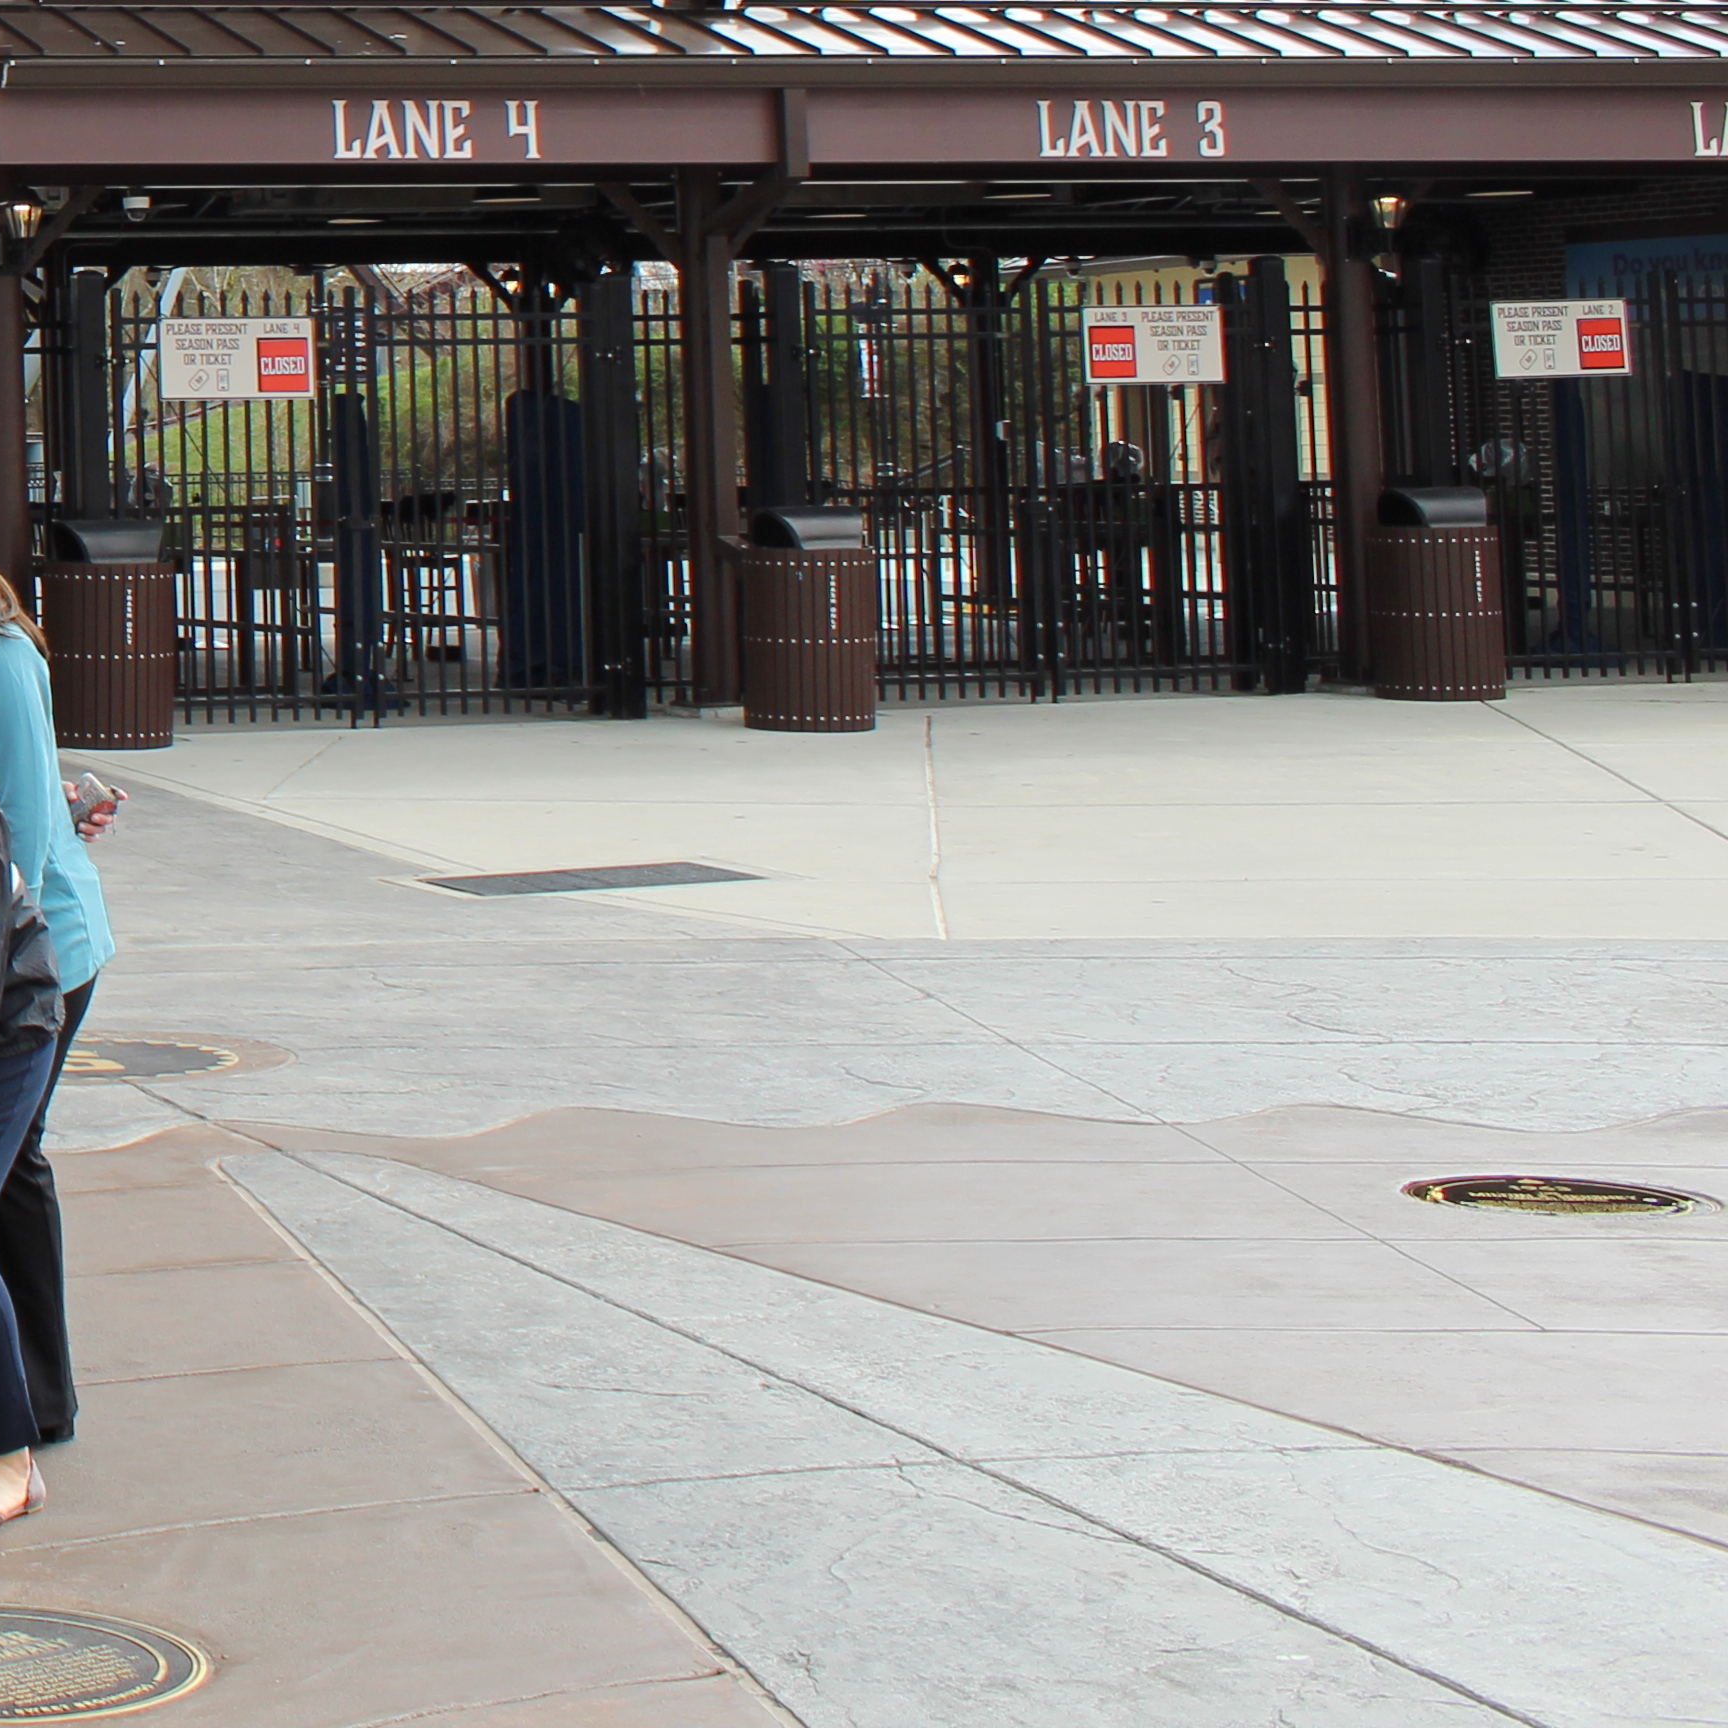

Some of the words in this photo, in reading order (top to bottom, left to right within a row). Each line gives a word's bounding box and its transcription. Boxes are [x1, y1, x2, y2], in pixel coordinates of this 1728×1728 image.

[331, 100, 473, 160] LANE
[505, 100, 541, 160] 4
[1037, 100, 1168, 158] LANE
[1197, 100, 1226, 158] 3
[1689, 102, 1728, 156] L
[1497, 307, 1529, 318] PLEASE
[1531, 306, 1569, 317] PRESENT
[1582, 305, 1604, 315] LANE
[1608, 305, 1614, 314] 2
[1094, 312, 1117, 322] LANE
[1121, 312, 1127, 322] 3
[1141, 311, 1174, 322] PLEASE
[1176, 311, 1215, 322] PRESENT
[166, 323, 203, 335] PLEASE
[205, 323, 248, 335] PRESENT
[263, 323, 288, 333] LANE
[293, 323, 300, 333] 4
[1150, 325, 1183, 336] SEASON
[1186, 325, 1207, 336] PASS
[1506, 320, 1539, 332] SEASON
[1542, 320, 1562, 331] PASS
[175, 338, 213, 350] SEASON
[216, 338, 240, 350] PASS
[1157, 340, 1168, 351] OR
[1171, 339, 1201, 350] TICKET
[1514, 335, 1525, 346] OR
[1528, 334, 1557, 345] TICKET
[1581, 334, 1621, 352] CLOSED
[1092, 344, 1133, 361] CLOSED
[183, 354, 196, 365] OR
[199, 354, 232, 365] TICKET
[260, 356, 305, 375] CLOSED
